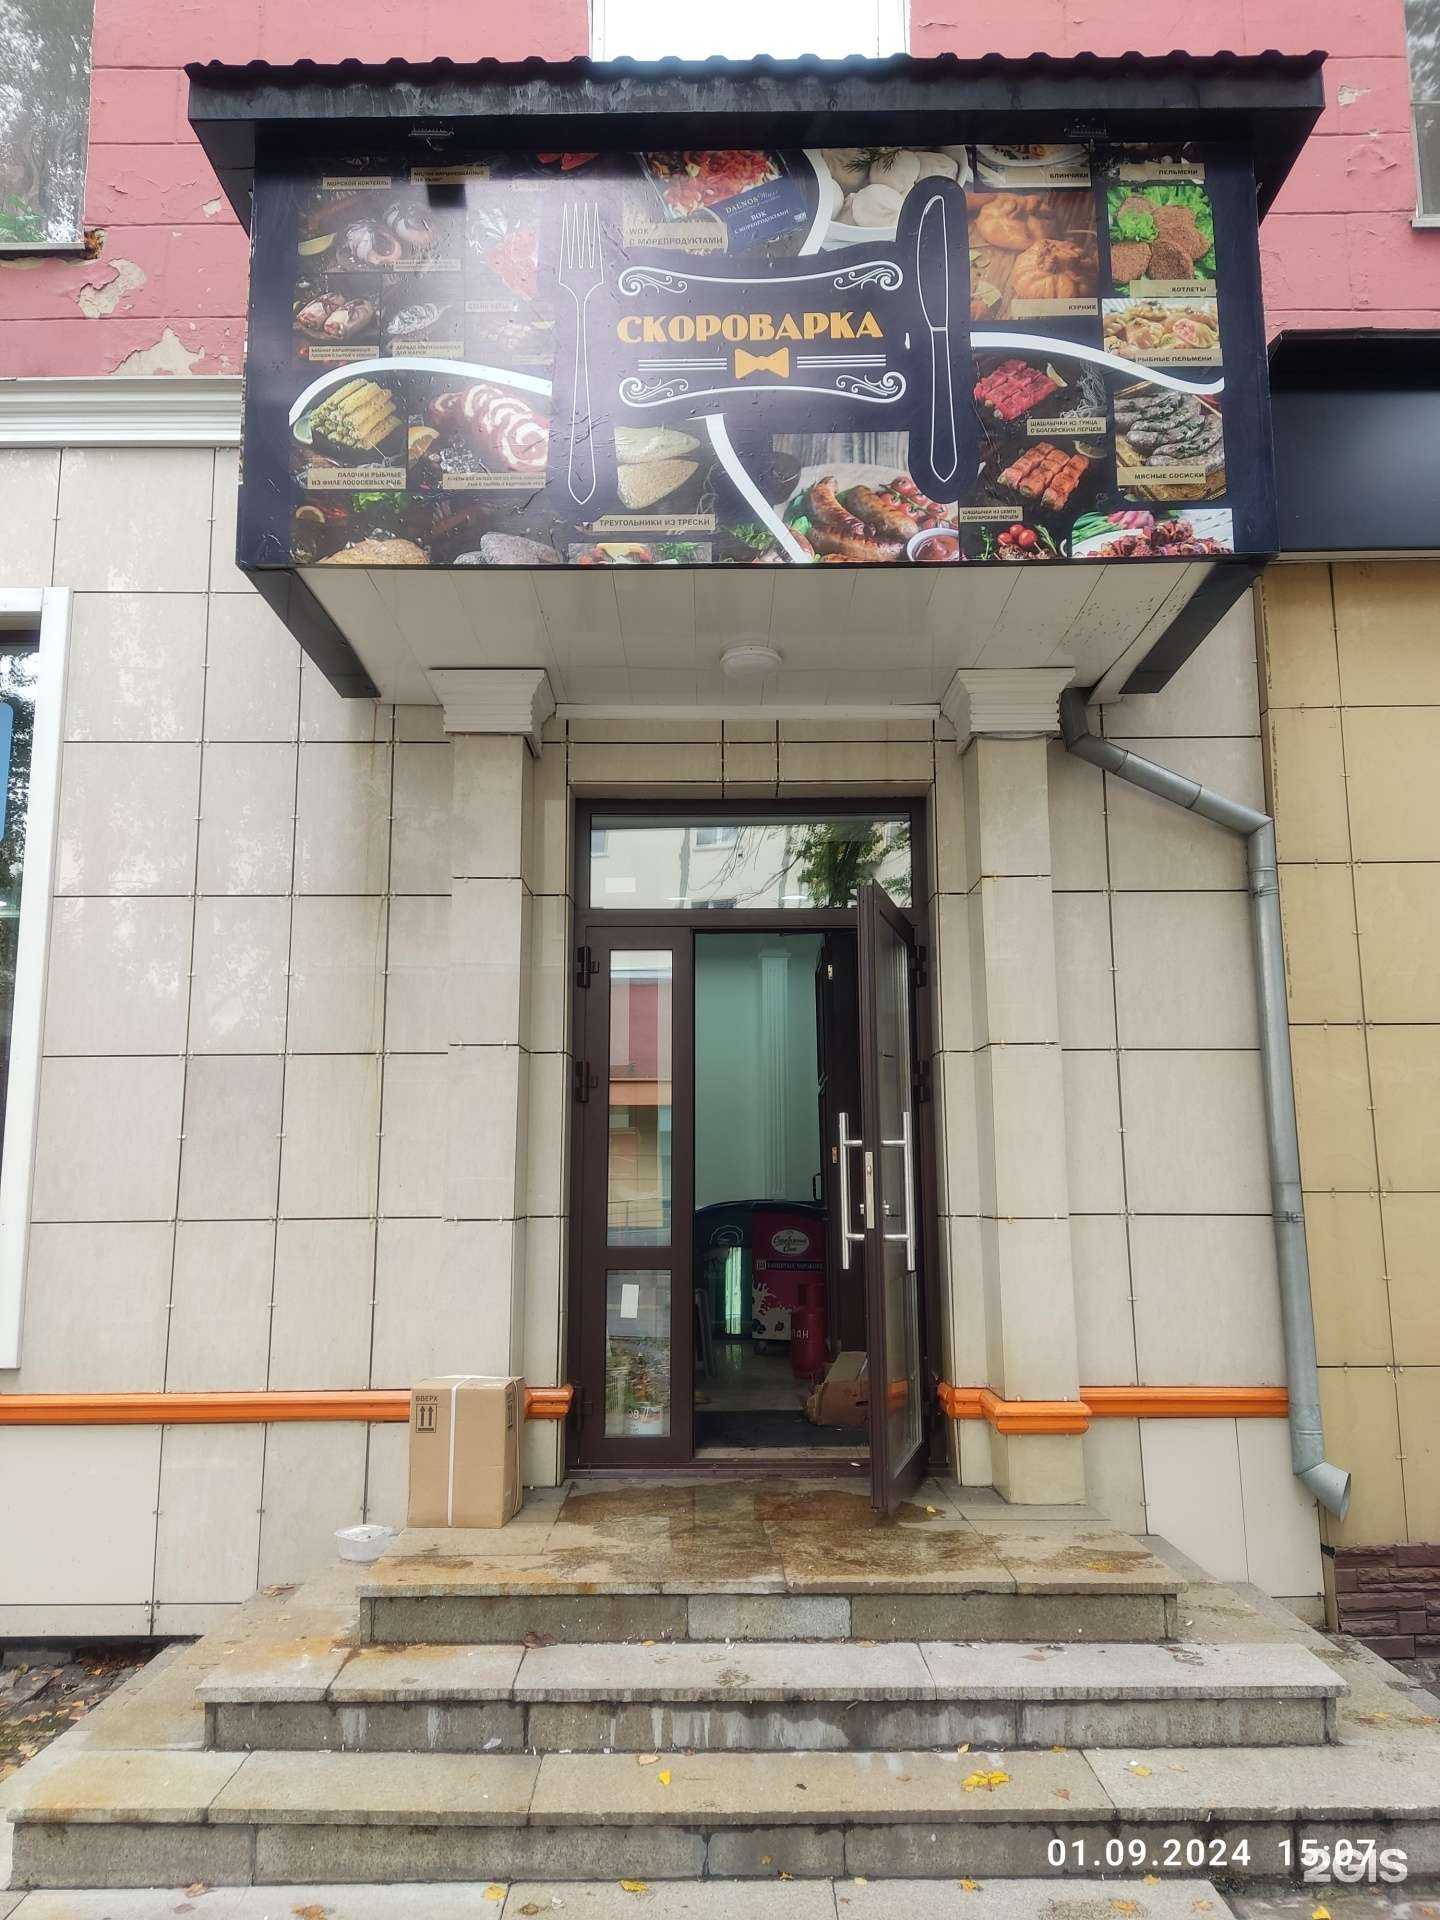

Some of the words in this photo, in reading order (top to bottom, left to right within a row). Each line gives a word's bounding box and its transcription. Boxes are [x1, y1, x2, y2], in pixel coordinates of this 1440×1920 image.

[637, 237, 723, 246] МОРЕПРОДУКТАМИ
[1068, 303, 1097, 311] КУРНИК
[616, 312, 884, 343] СКОРОВАРКА
[599, 518, 662, 527] ТРЕУГОЛЬНИКИ
[664, 518, 676, 526] ИЗ
[678, 518, 710, 526] ТРЕСКИ
